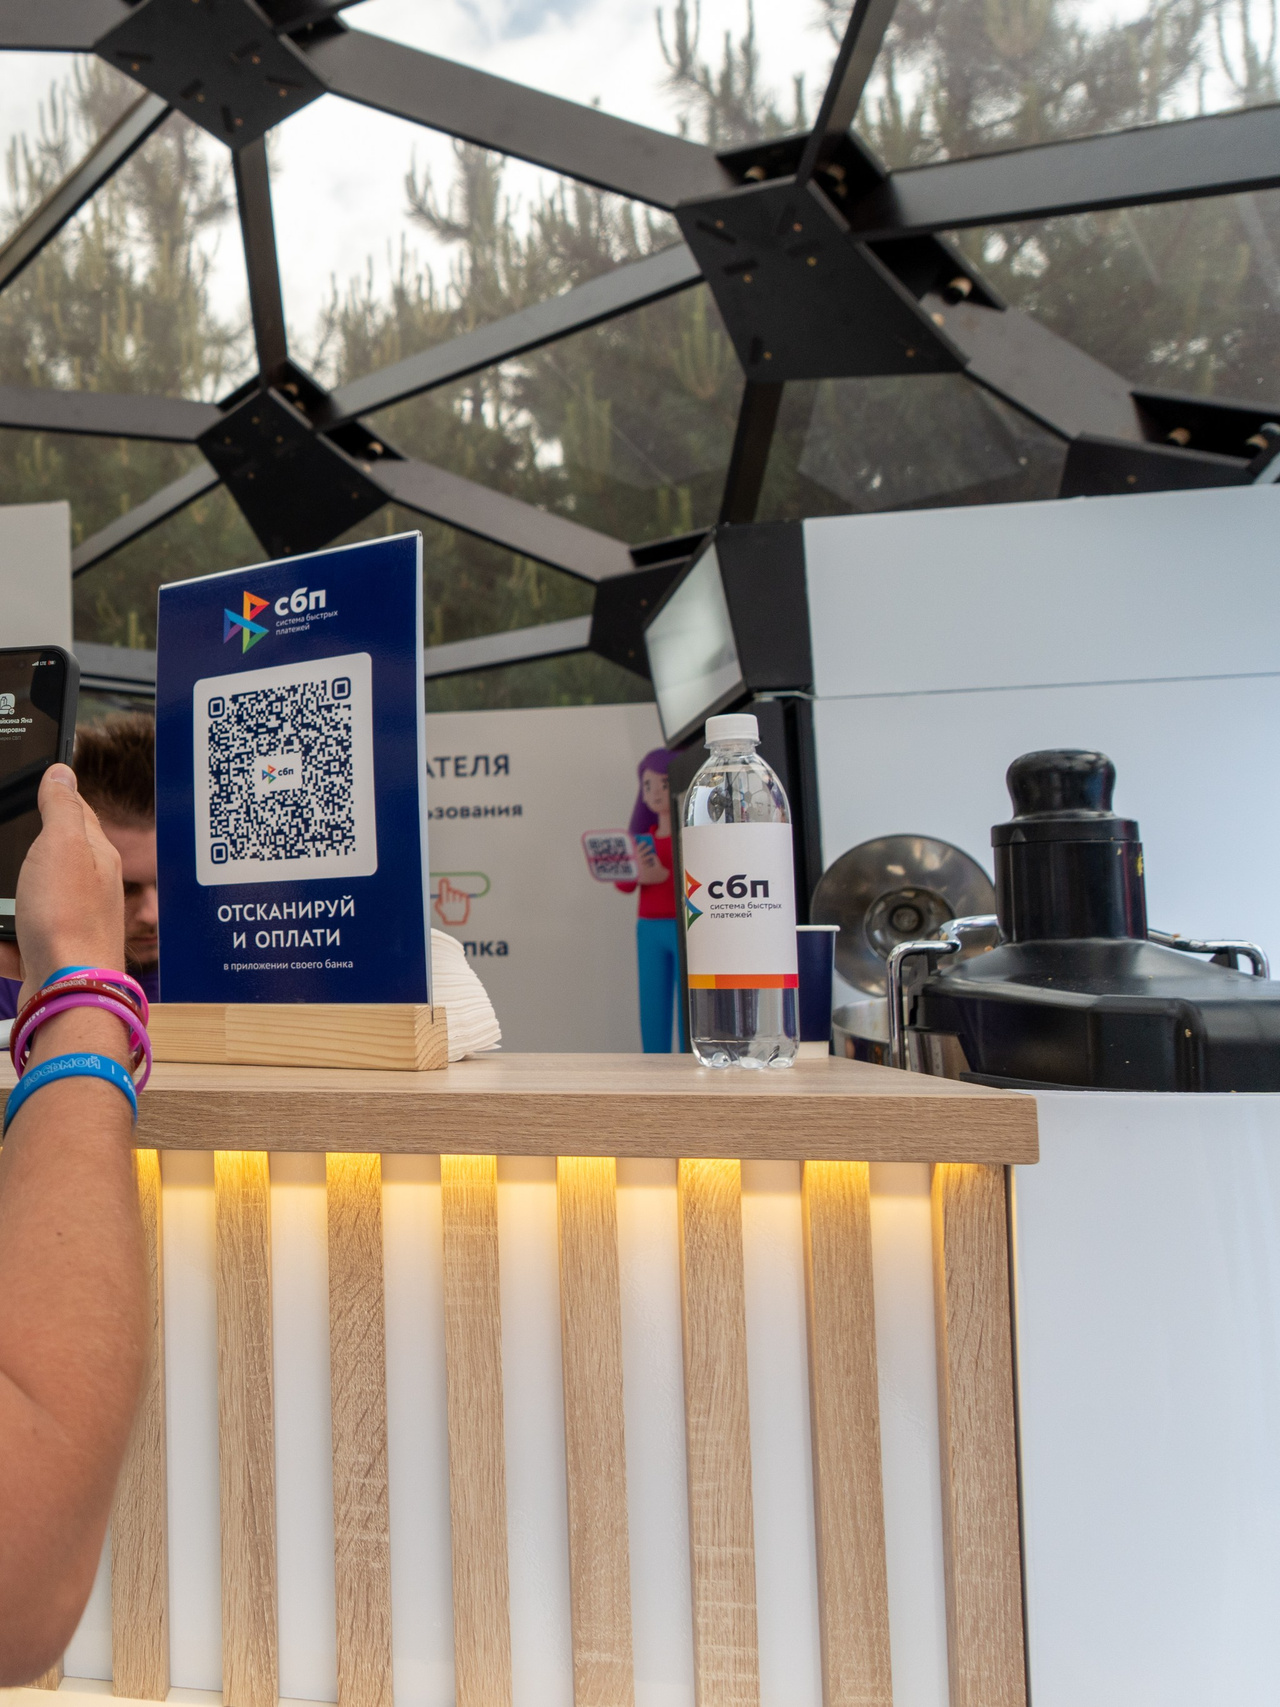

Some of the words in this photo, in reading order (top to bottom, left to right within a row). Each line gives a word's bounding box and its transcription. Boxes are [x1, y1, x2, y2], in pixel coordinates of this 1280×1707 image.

[274, 587, 326, 616] сбп
[276, 616, 305, 627] система
[305, 610, 338, 621] быстрых
[275, 623, 310, 635] платежей
[277, 767, 294, 777] сбп
[707, 874, 770, 899] сбп
[217, 895, 355, 923] ОТСКАНИРУЙ
[747, 901, 782, 911] быстрых
[710, 911, 753, 919] платежей
[233, 931, 247, 949] И
[255, 928, 341, 949] ОПЛАТИ
[223, 962, 229, 970] в
[231, 961, 289, 972] приложении
[290, 960, 323, 969] своего
[324, 959, 354, 969] банка
